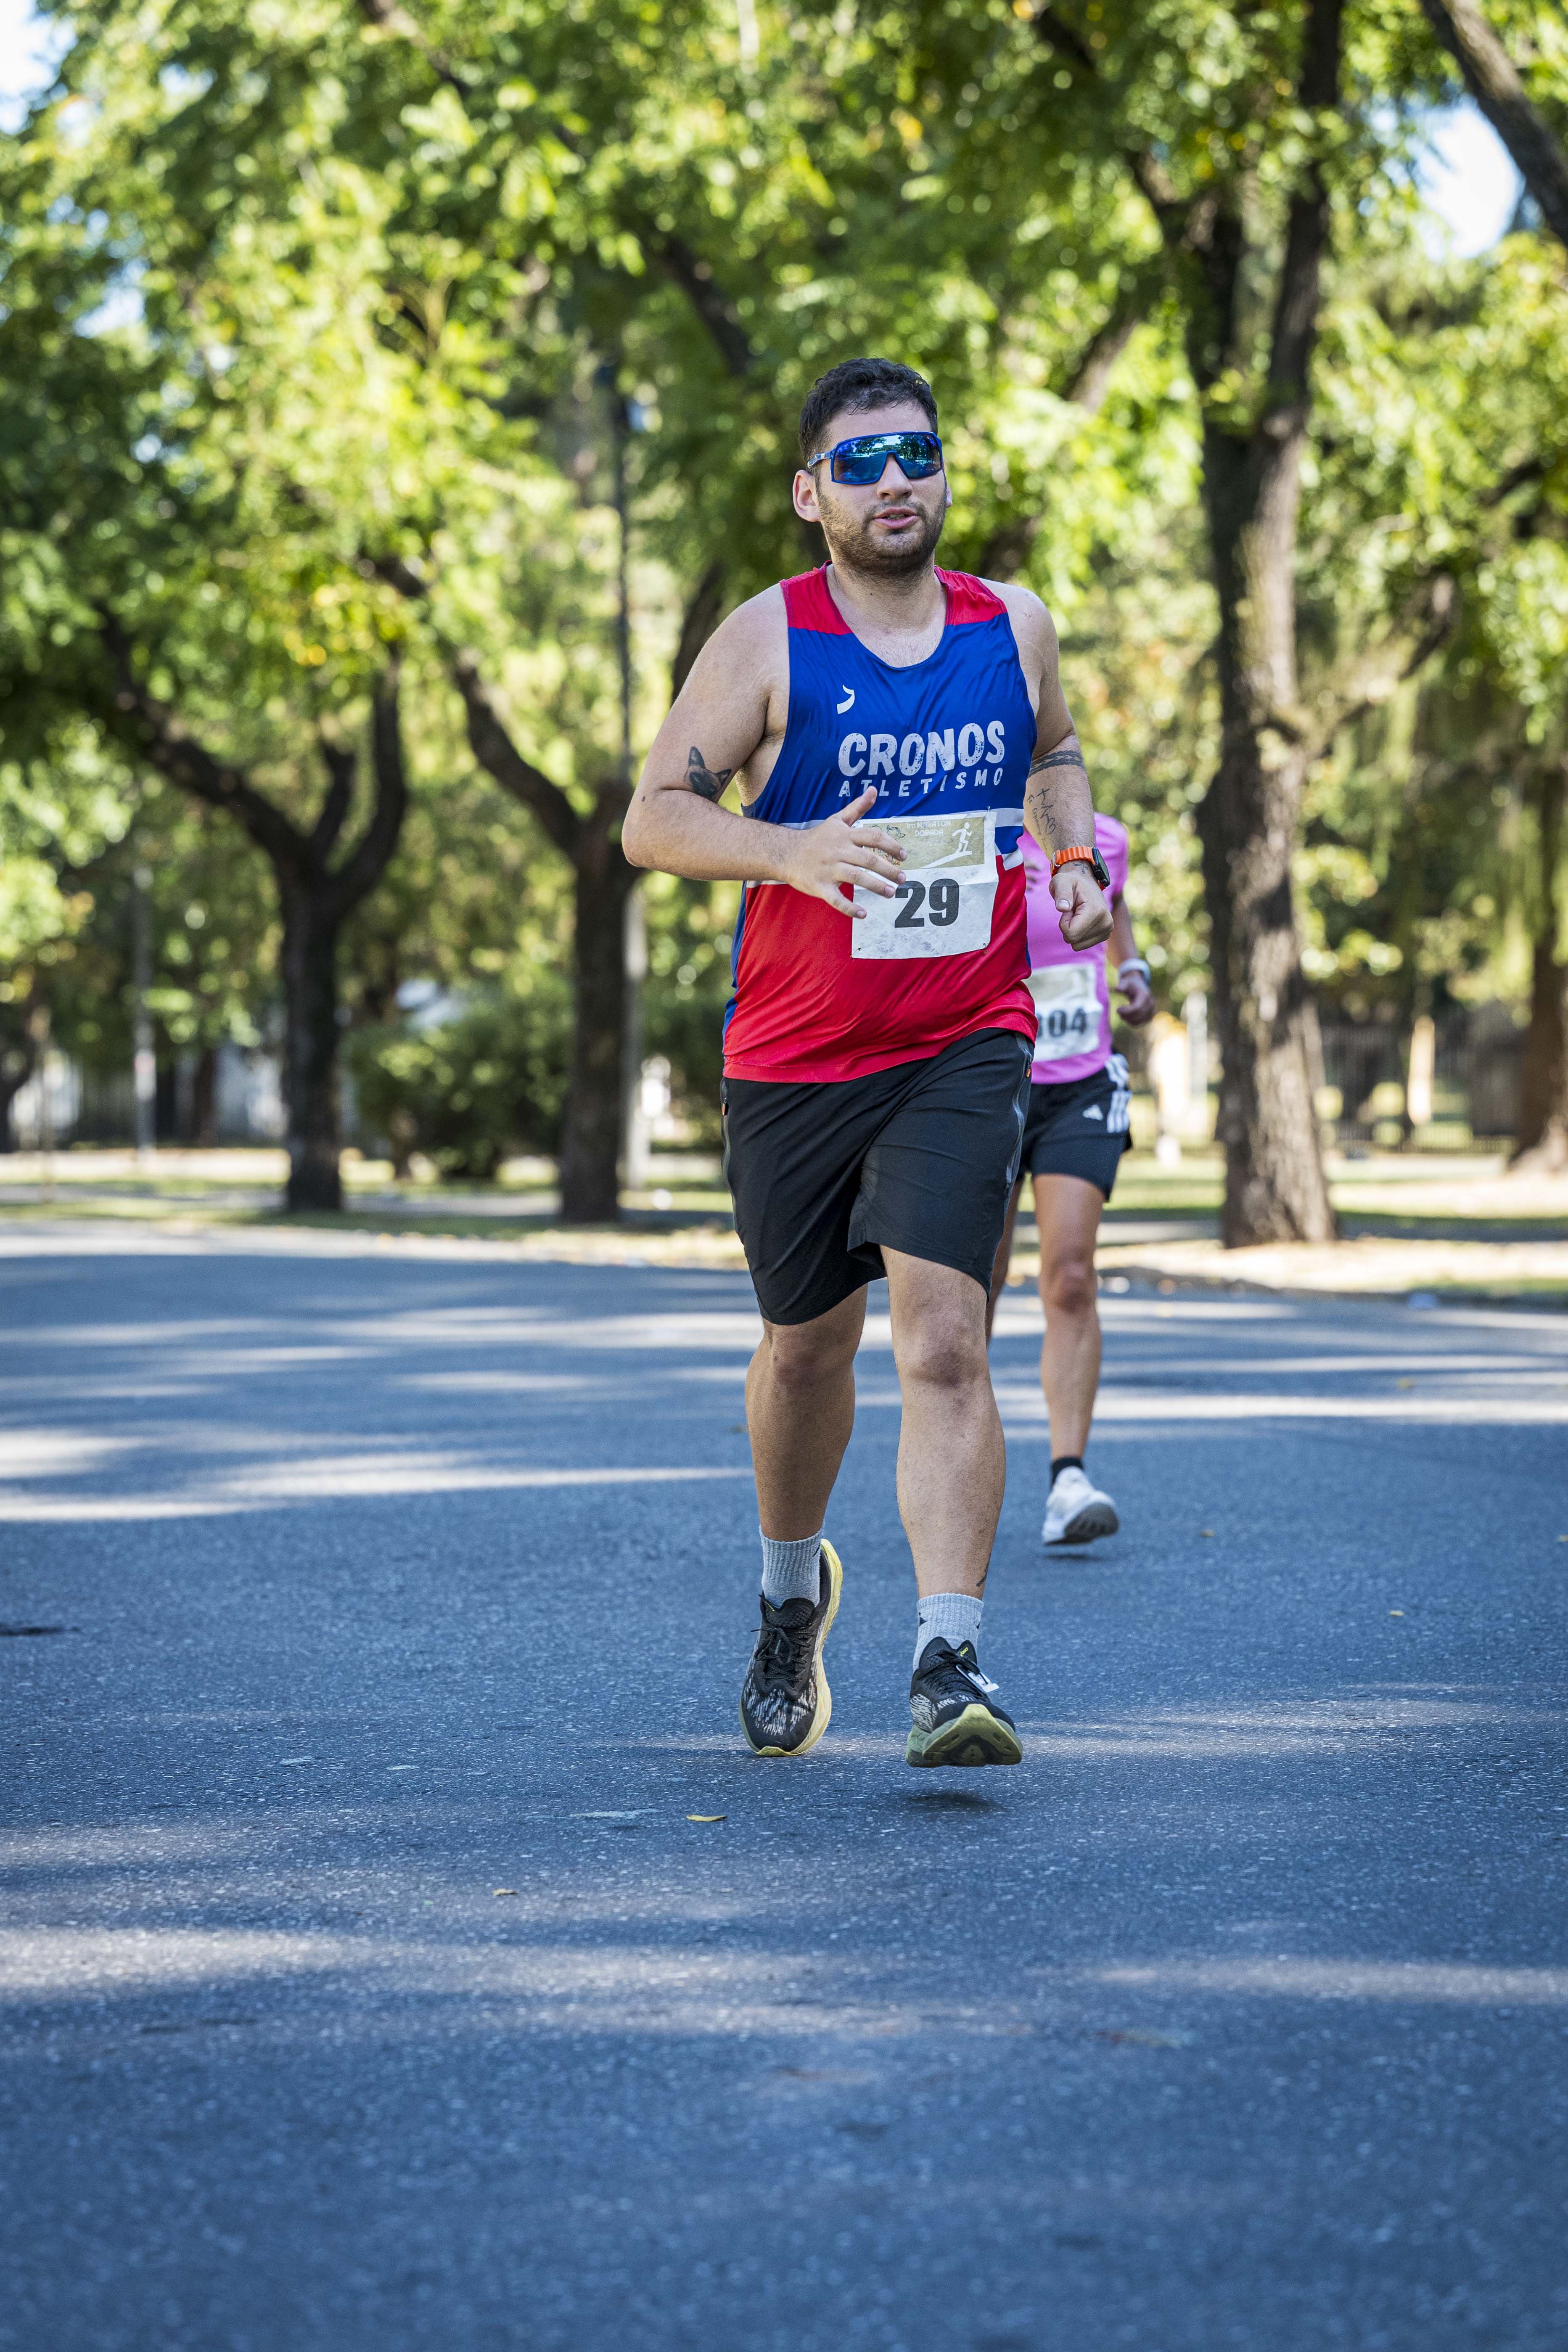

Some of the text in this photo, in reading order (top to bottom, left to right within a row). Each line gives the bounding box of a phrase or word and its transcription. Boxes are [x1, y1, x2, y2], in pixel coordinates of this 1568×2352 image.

[838, 720, 1005, 777] CRONOS
[838, 767, 1003, 797] ATLETISMO
[915, 828, 944, 837] DORADA
[894, 878, 960, 928] 29
